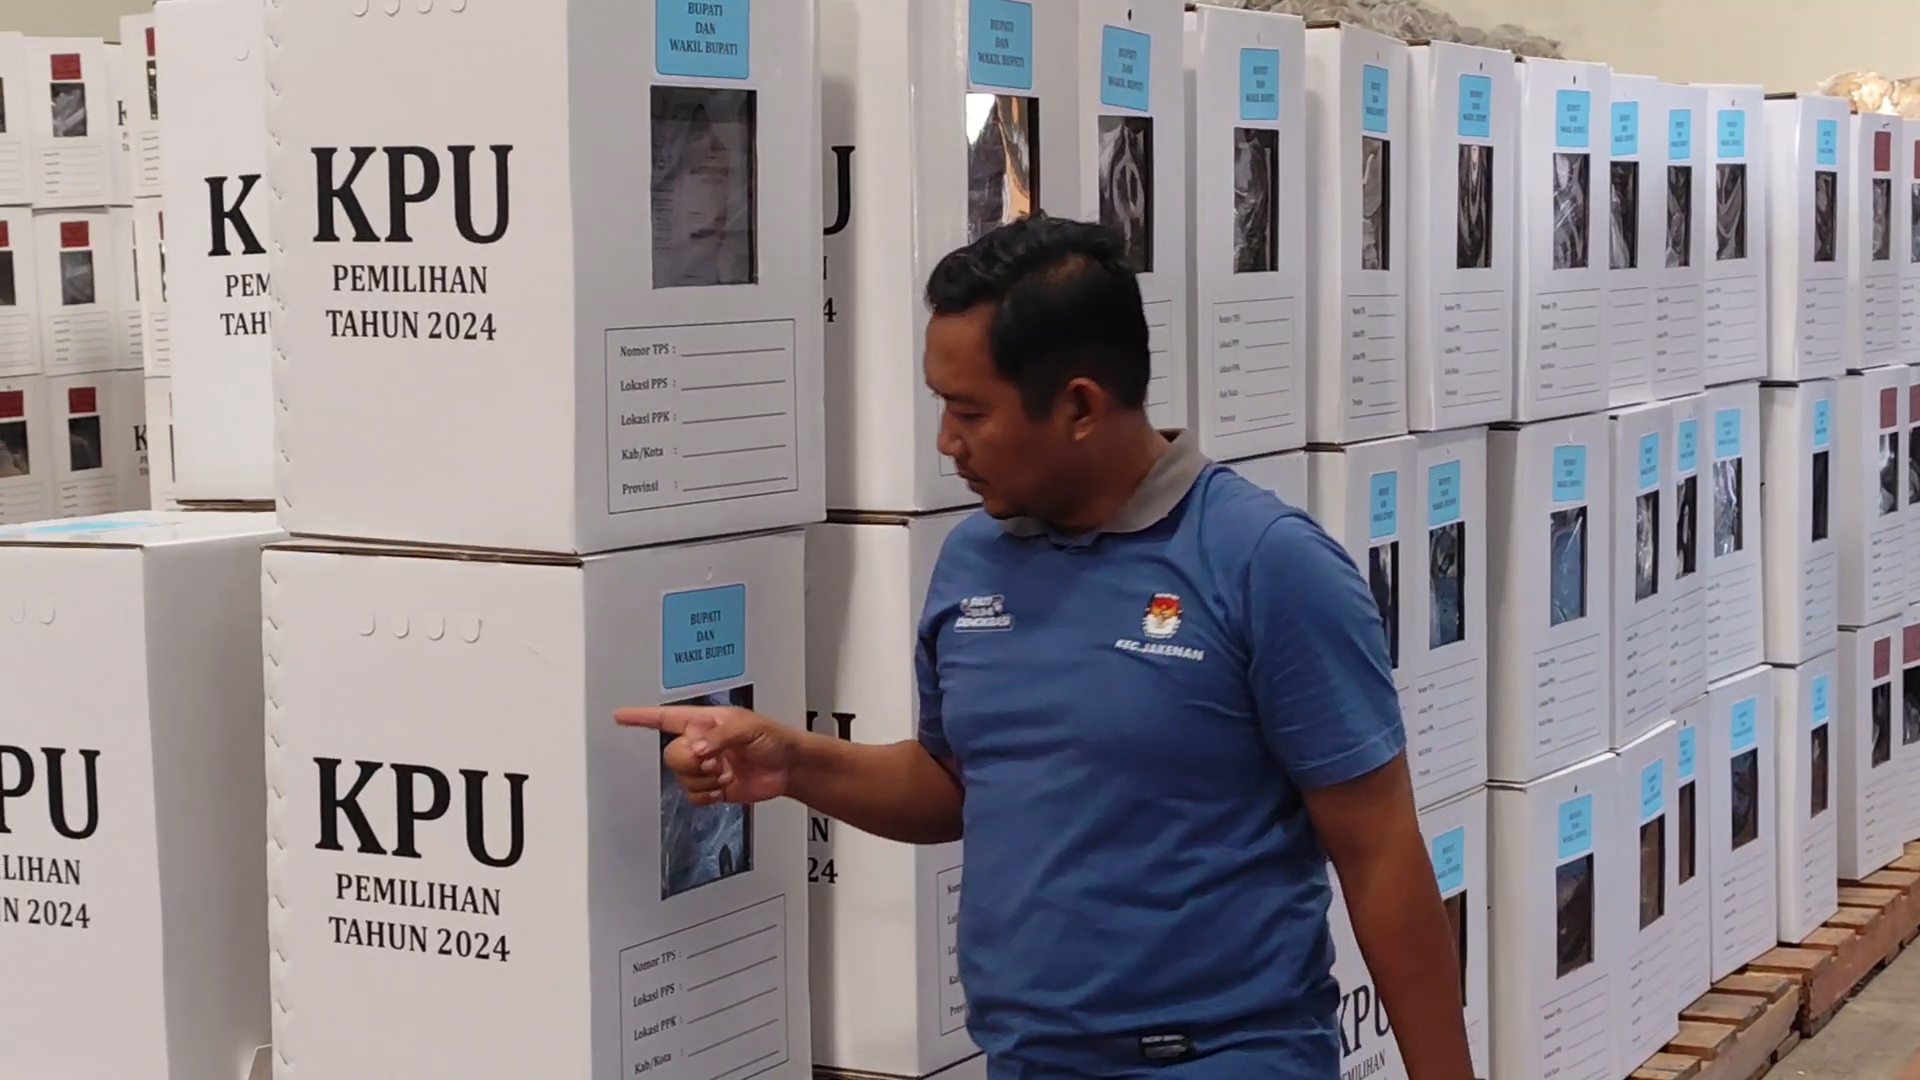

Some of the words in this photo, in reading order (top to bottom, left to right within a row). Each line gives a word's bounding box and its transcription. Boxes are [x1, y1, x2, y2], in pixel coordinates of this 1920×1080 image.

[688, 2, 723, 17] BUPATI
[695, 22, 716, 35] DAN
[669, 38, 703, 53] WAKIL
[705, 41, 738, 55] BUPATI
[310, 144, 513, 244] KPU
[332, 264, 488, 294] PEMILIHAN
[220, 310, 272, 336] TAH
[325, 309, 419, 339] TAHUN
[427, 311, 497, 341] 2024
[620, 345, 650, 357] Nomor
[652, 343, 670, 355] TPS
[620, 379, 650, 392] Lokasi
[651, 377, 668, 390] PPS
[621, 413, 650, 426] Lokasi
[651, 411, 670, 423] PPK
[621, 446, 664, 461] Kab/Kota
[622, 480, 659, 495] Provinsi
[690, 610, 721, 626] BUPATI
[696, 629, 715, 643] DAN
[674, 649, 703, 664] WAKIL
[705, 643, 735, 660] BUPATI
[313, 757, 529, 868] KPU
[0, 854, 80, 886] LIHAN
[335, 872, 501, 917] PEMILIHAN
[27, 898, 90, 929] 2024
[328, 916, 428, 953] TAHUN
[437, 928, 510, 962] 2024
[632, 957, 660, 974] Nomor
[661, 950, 676, 964] TPS
[633, 988, 659, 1008] Lokasi
[660, 983, 675, 998] PPS
[633, 1022, 659, 1041] Lokasi
[660, 1015, 677, 1032] PPK
[634, 1052, 672, 1075] Kab/Kota
